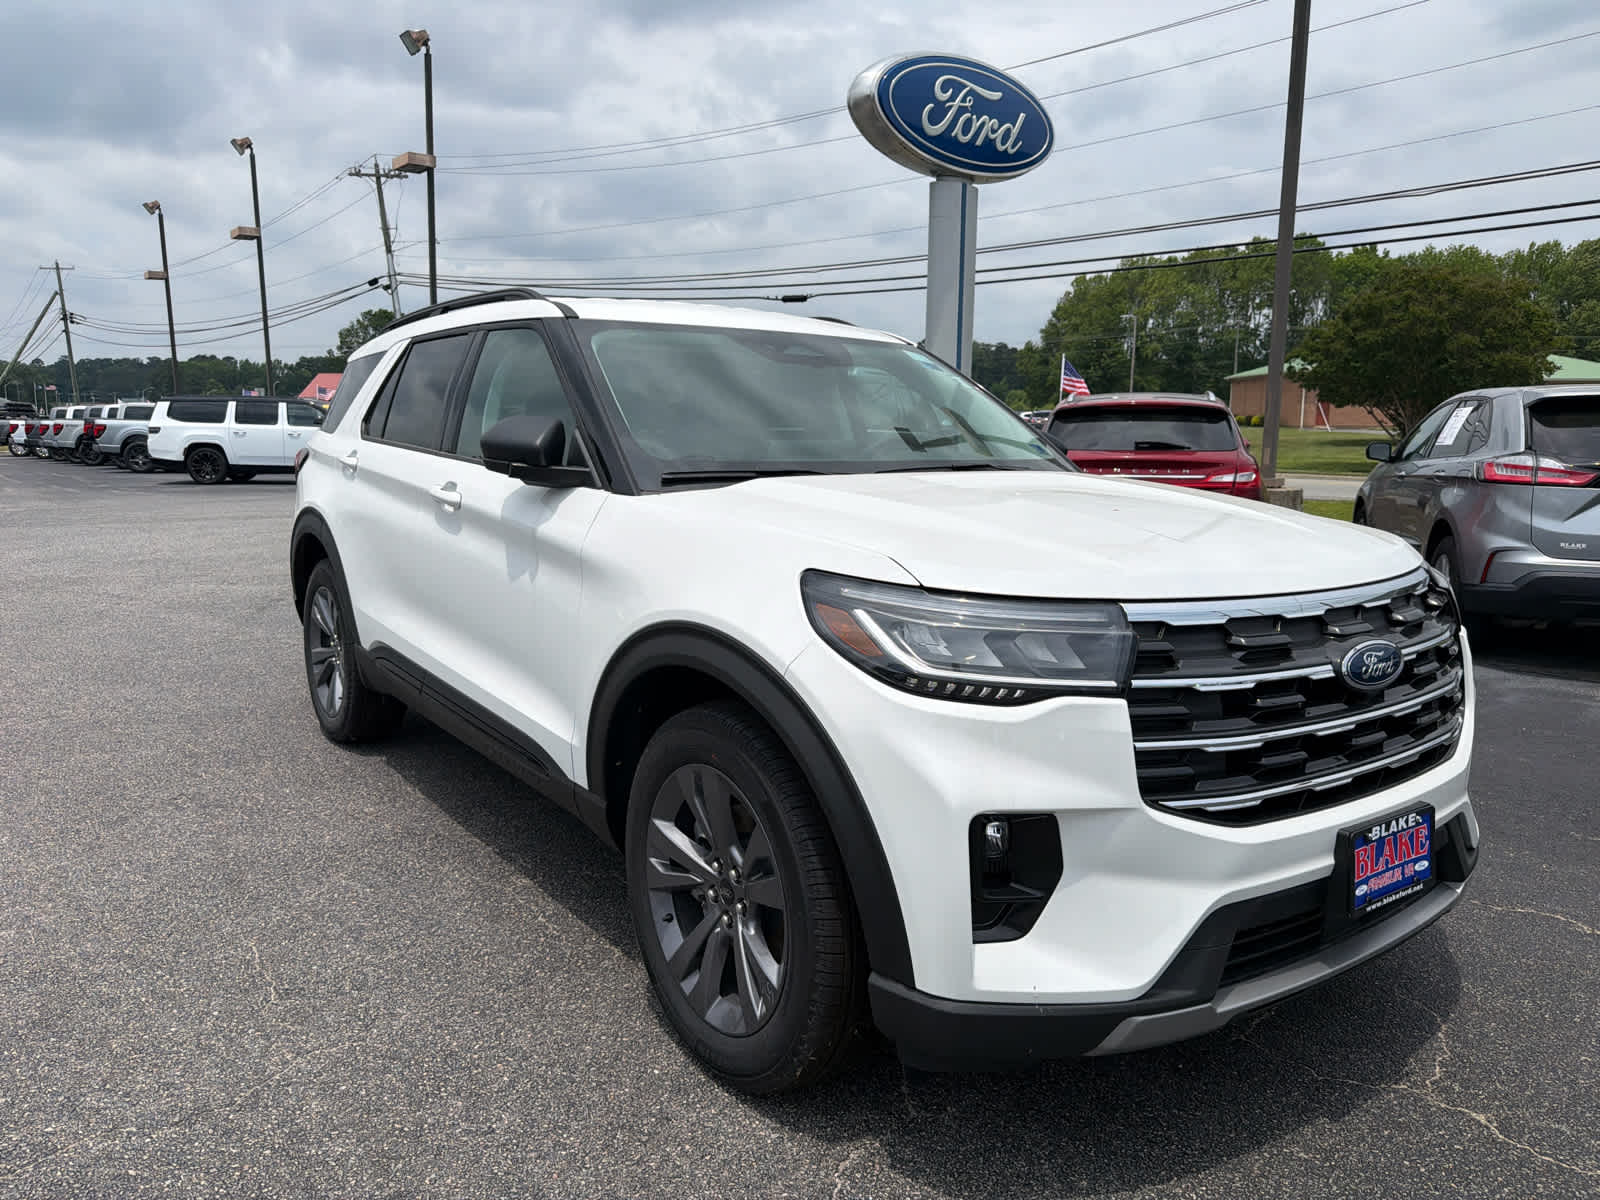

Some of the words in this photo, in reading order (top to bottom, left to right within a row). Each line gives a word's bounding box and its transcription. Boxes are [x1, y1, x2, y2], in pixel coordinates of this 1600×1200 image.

[922, 75, 1026, 155] Ford
[1361, 651, 1394, 679] Ford
[1371, 813, 1417, 840] BLAKE
[1355, 824, 1429, 882] BLAKE
[1366, 883, 1424, 912] www.blakeford.net
